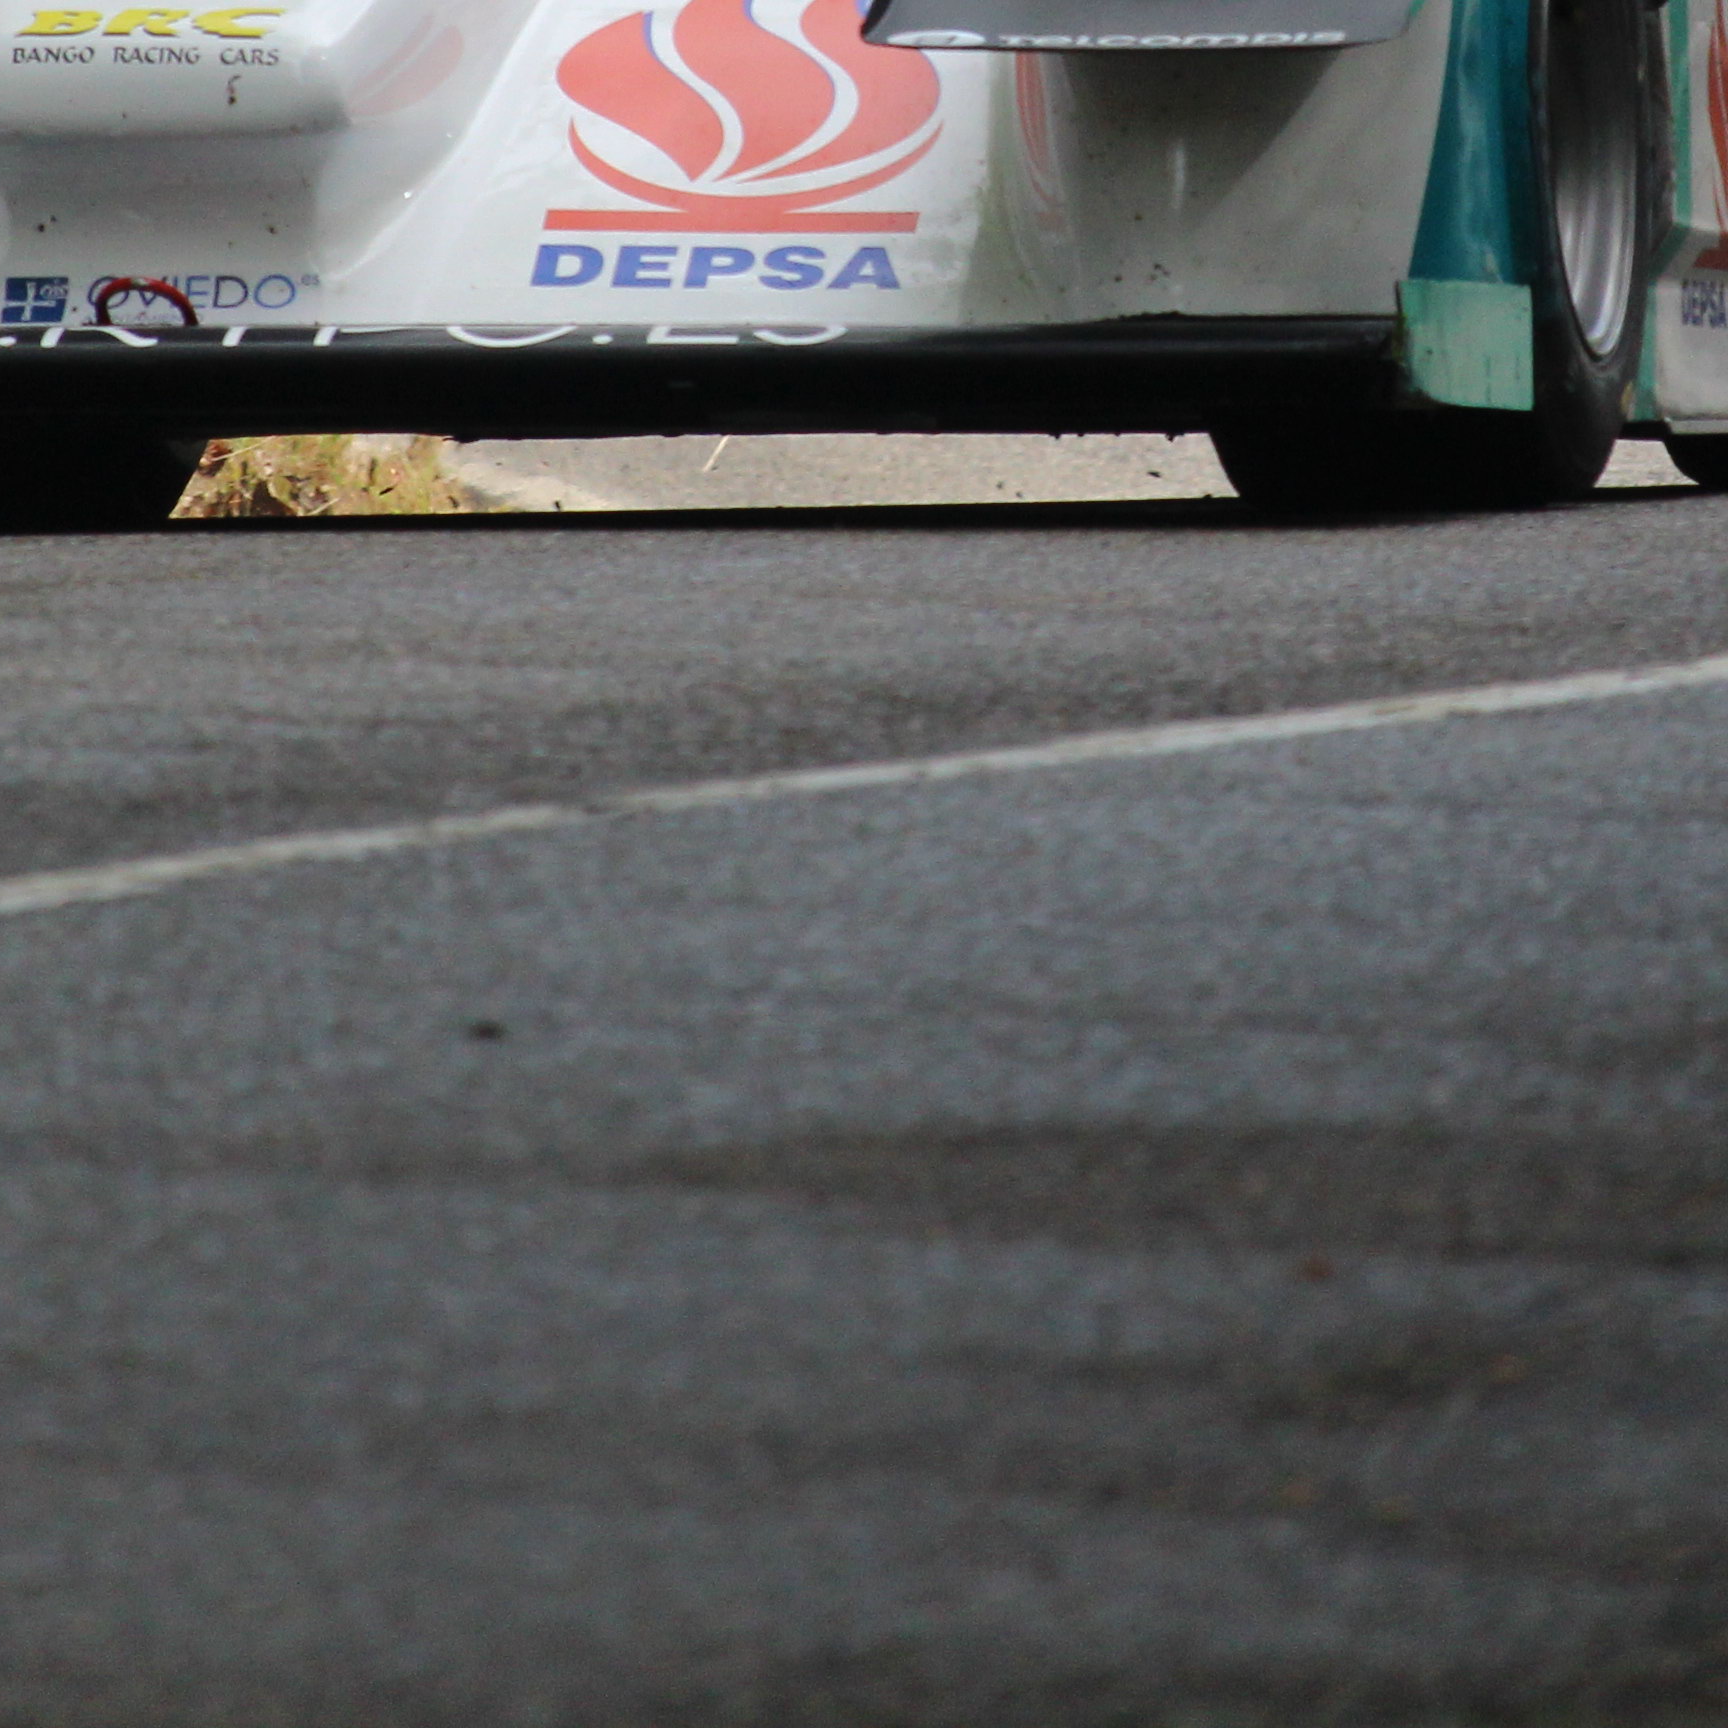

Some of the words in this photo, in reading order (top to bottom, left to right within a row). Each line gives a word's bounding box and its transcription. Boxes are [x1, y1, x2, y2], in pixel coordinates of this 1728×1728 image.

[14, 7, 287, 39] BRC
[12, 45, 96, 65] BANGO
[112, 45, 201, 66] RACING
[218, 47, 281, 67] CARS
[529, 243, 903, 291] DEPSA
